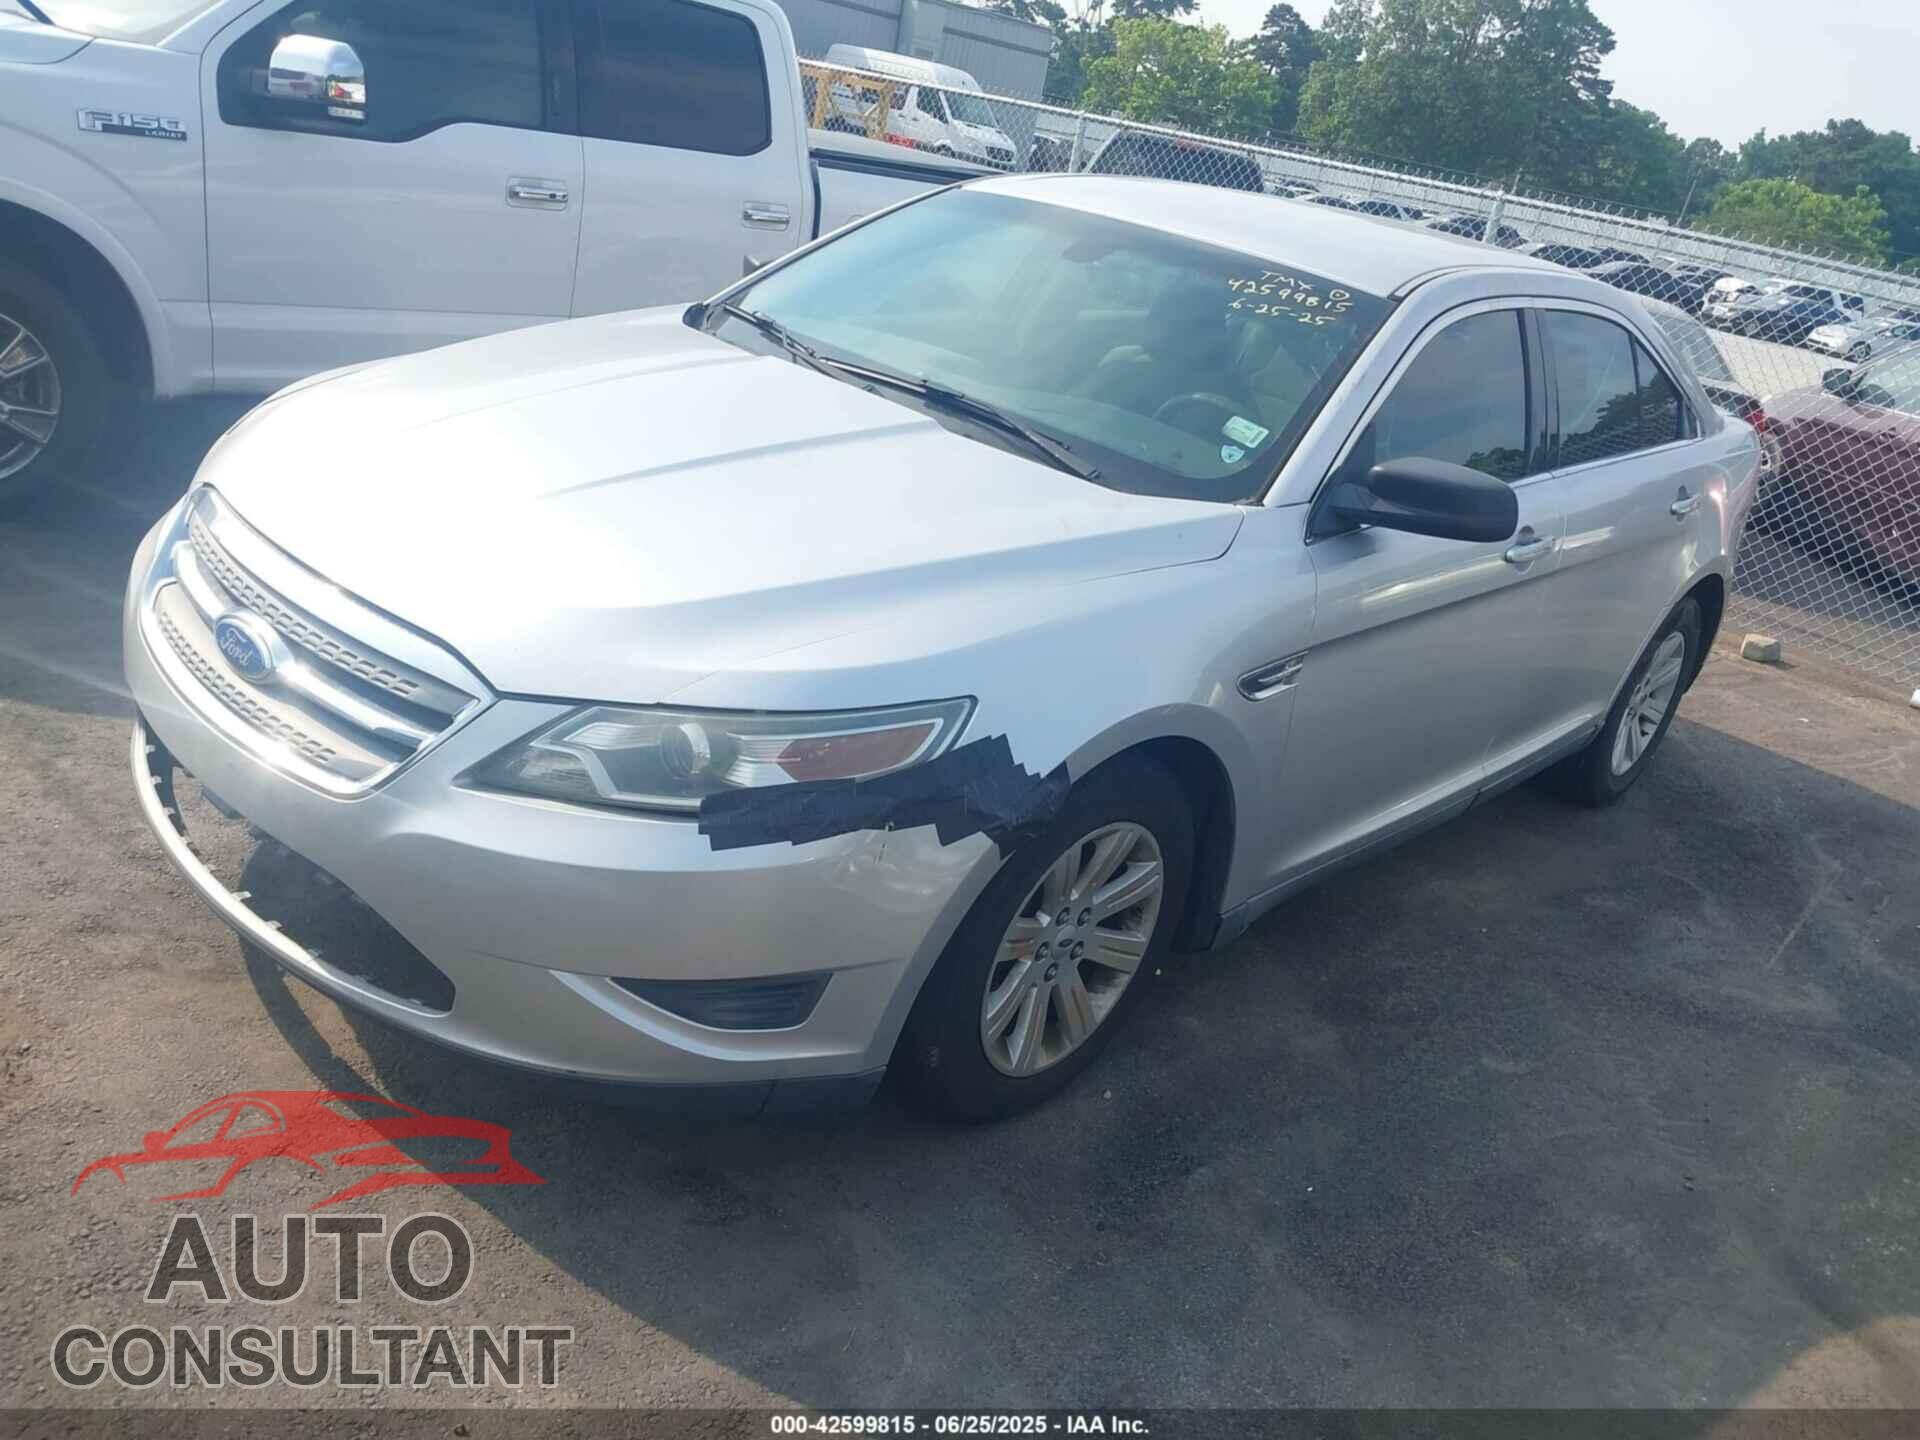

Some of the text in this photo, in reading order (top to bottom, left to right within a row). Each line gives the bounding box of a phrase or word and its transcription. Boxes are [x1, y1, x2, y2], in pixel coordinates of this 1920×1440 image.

[1228, 278, 1354, 313] 42599815
[1228, 297, 1336, 325] 6-25-25
[220, 627, 254, 666] Ford
